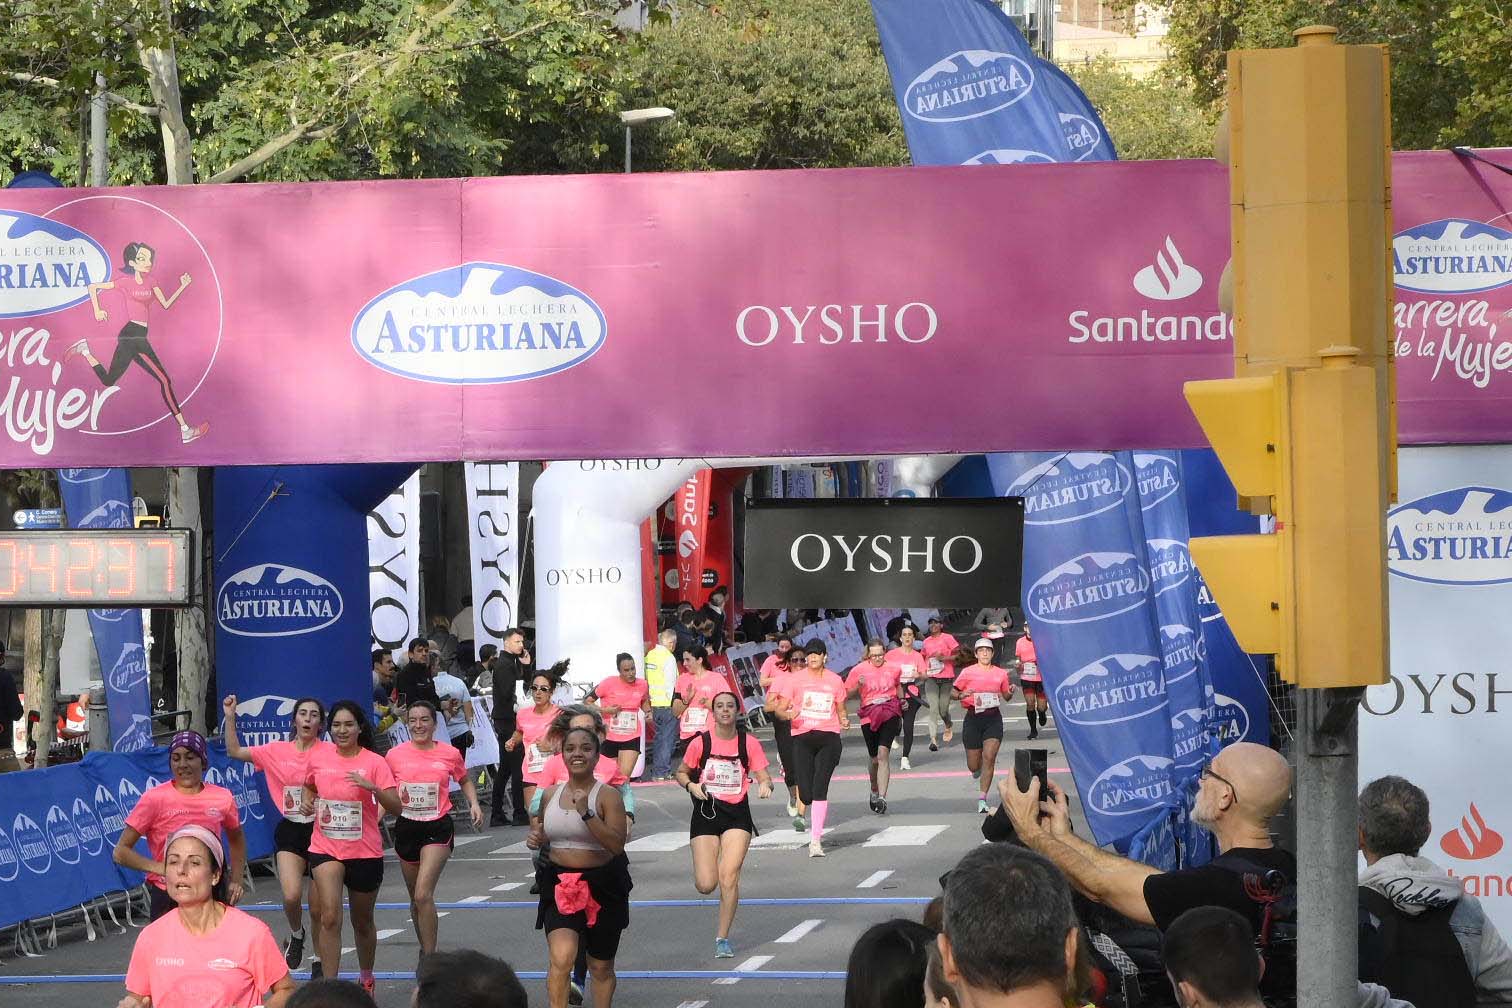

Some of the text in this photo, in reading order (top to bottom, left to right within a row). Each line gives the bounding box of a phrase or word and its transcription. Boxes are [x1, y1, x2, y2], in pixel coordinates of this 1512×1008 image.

[14, 245, 86, 257] LECHERA
[1408, 243, 1512, 253] CENTRAL LECHER
[411, 303, 578, 318] CENTRAL LECHERA
[735, 302, 939, 347] OYSHO
[1394, 300, 1490, 329] arrera
[371, 310, 587, 354] ASTURIANA
[1067, 309, 1234, 344] Santand
[1417, 330, 1436, 357] la
[1430, 323, 1512, 388] Muje
[1414, 522, 1482, 532] CENTRAL
[790, 533, 984, 574] OYSHO
[1388, 525, 1512, 561] ASTURI
[546, 566, 623, 586] OYSHO
[221, 593, 335, 621] ASTURIANA
[233, 588, 329, 598] CENTRAL LECHERA
[1361, 671, 1512, 716] OYSH
